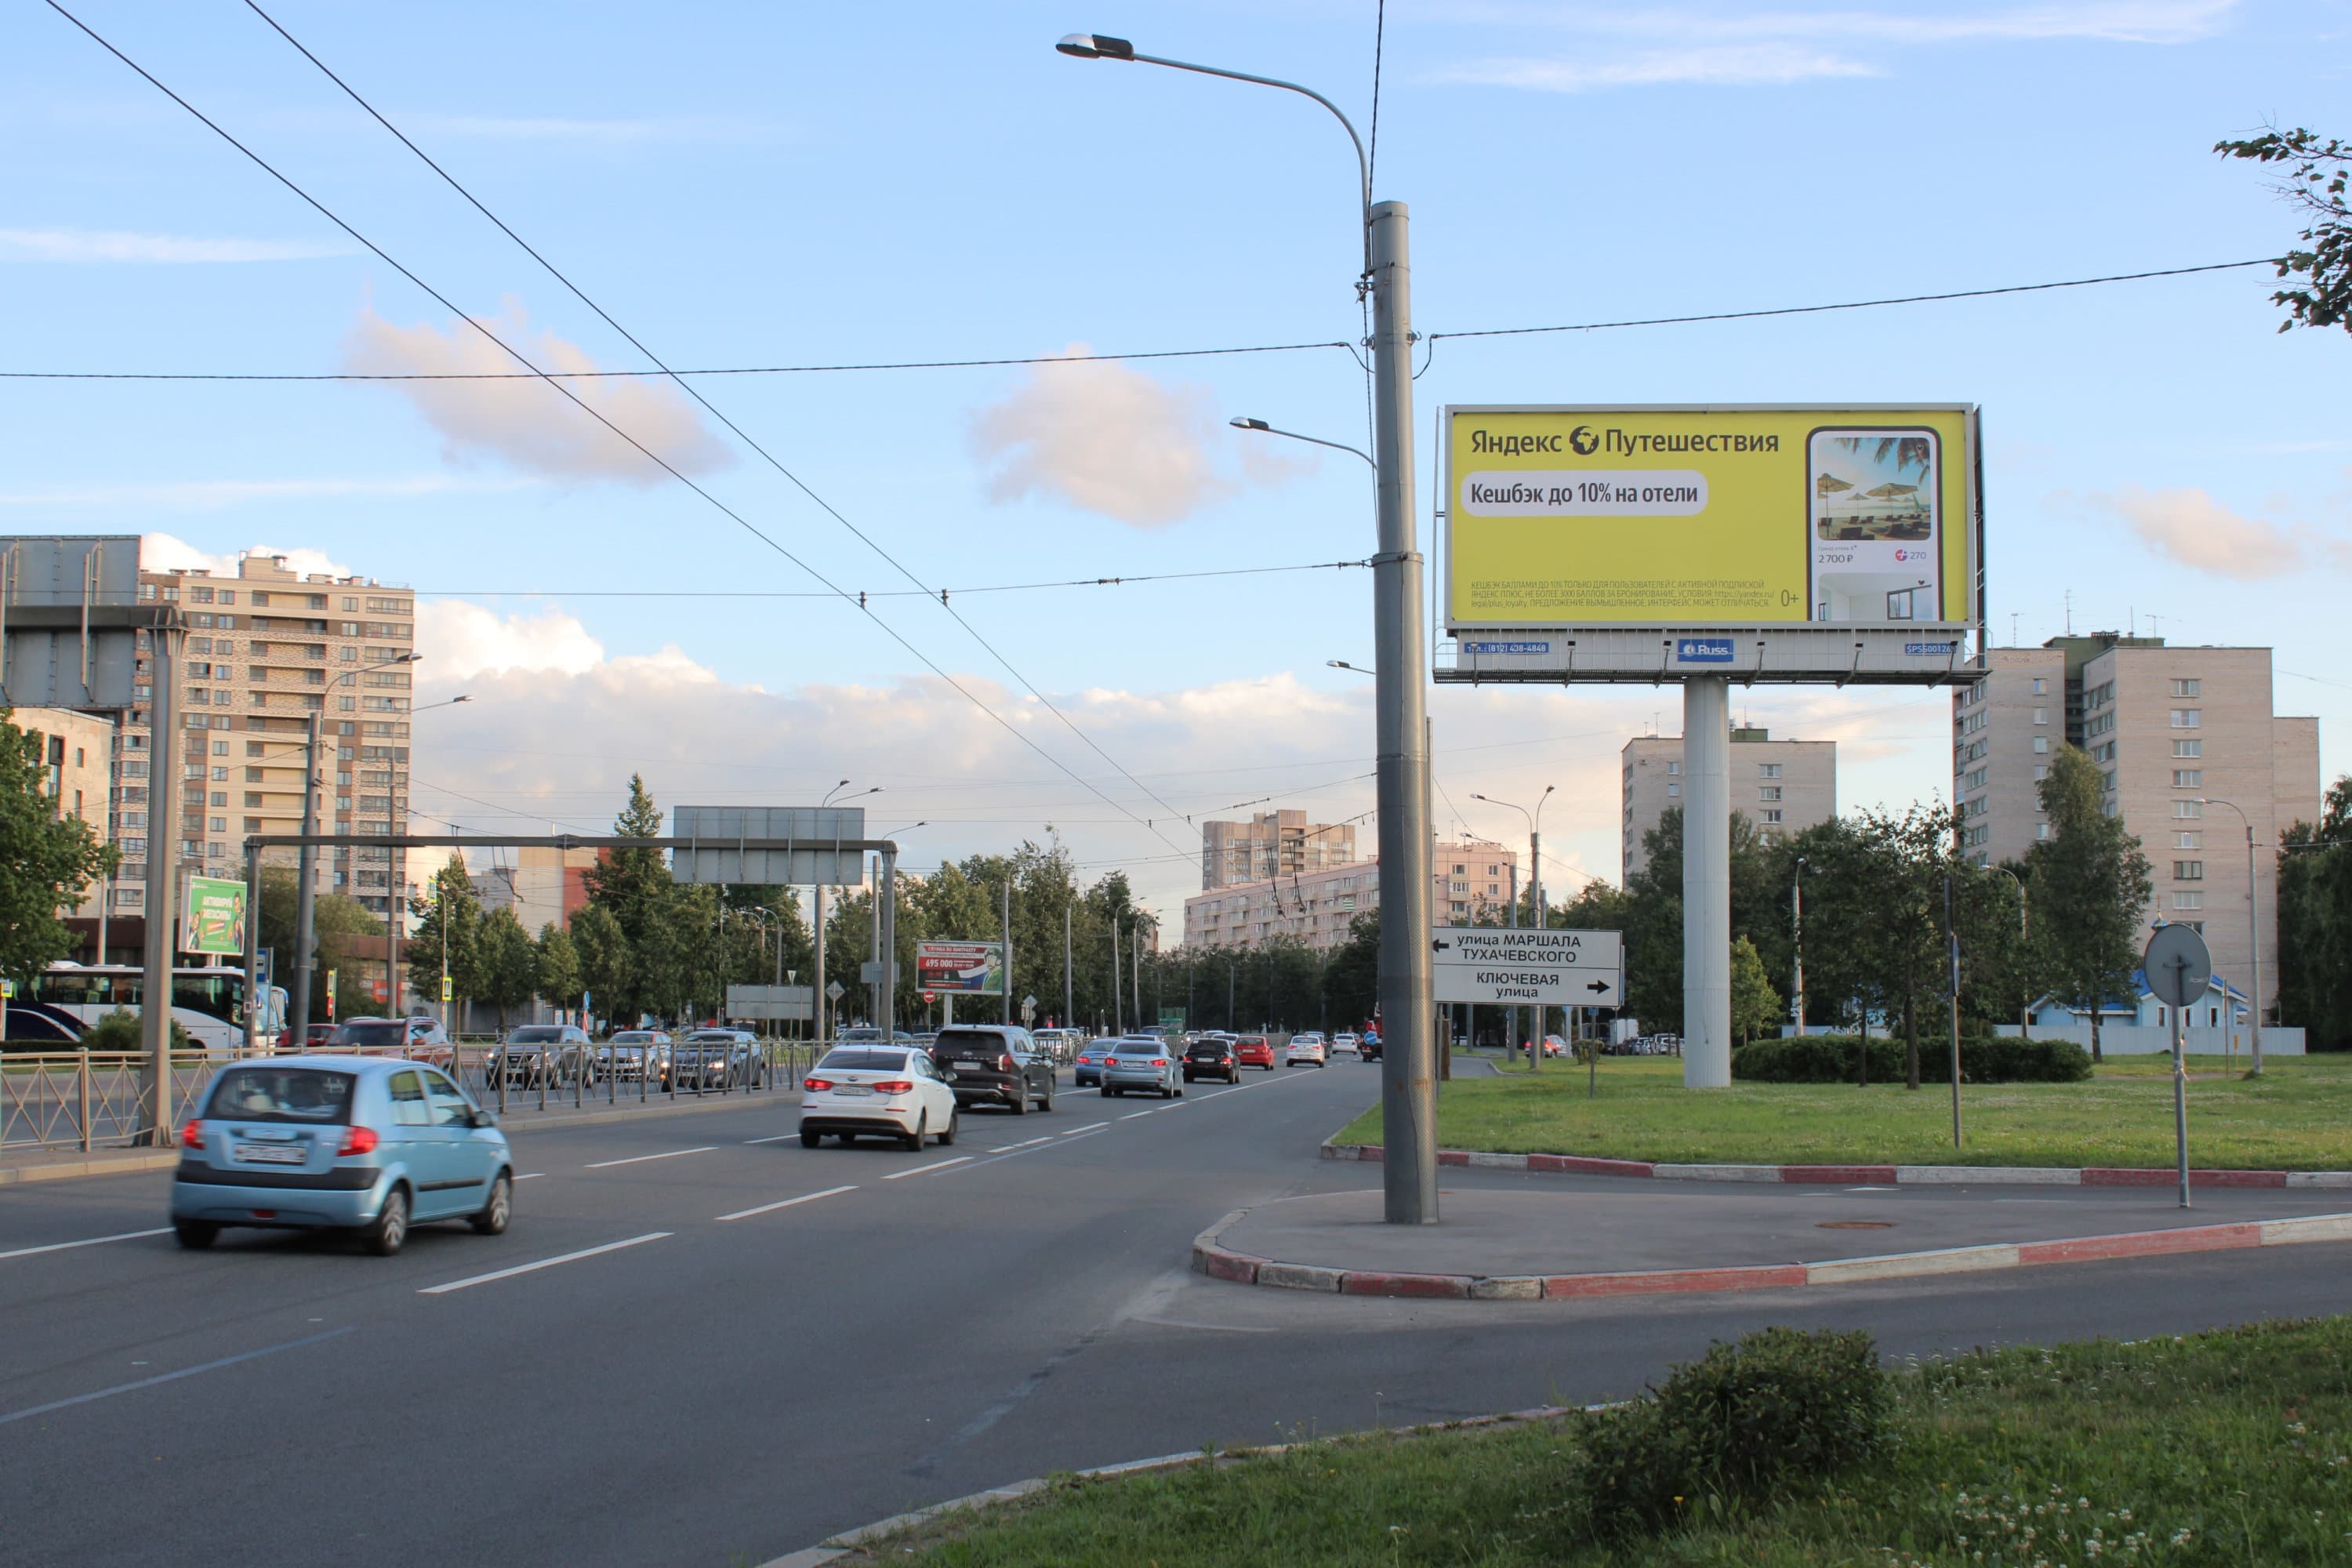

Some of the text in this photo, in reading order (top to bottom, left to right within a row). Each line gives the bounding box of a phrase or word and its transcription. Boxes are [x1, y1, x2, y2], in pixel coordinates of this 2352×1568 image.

[1472, 429, 1779, 457] Яндекс Путешествия
[1471, 483, 1697, 506] Кешбэк до 10% на отели
[1910, 552, 1926, 560] 270
[1538, 581, 1549, 589] ДО
[1610, 579, 1670, 588] ПОЛЬЗОВАТЕЛЕЙ
[1678, 579, 1717, 588] АКТИВНОЙ
[1719, 579, 1764, 588] ПОДПИСКОЙ
[1472, 590, 1499, 598] ЯНДЕКС
[1780, 589, 1799, 607] 0+
[1530, 599, 1585, 607] ПРЕДЛОЖЕНИЕ
[1648, 599, 1692, 607] ИНТЕРФЕЙС
[1488, 644, 1508, 653] (812)
[1698, 644, 1728, 655] Russ
[1457, 934, 1581, 948] улица МАРШАЛА
[1462, 949, 1576, 963] ТУХАЧЕВСКОГО
[1477, 972, 1559, 985] КЛЮЧЕВАЯ
[1496, 987, 1538, 999] улица
